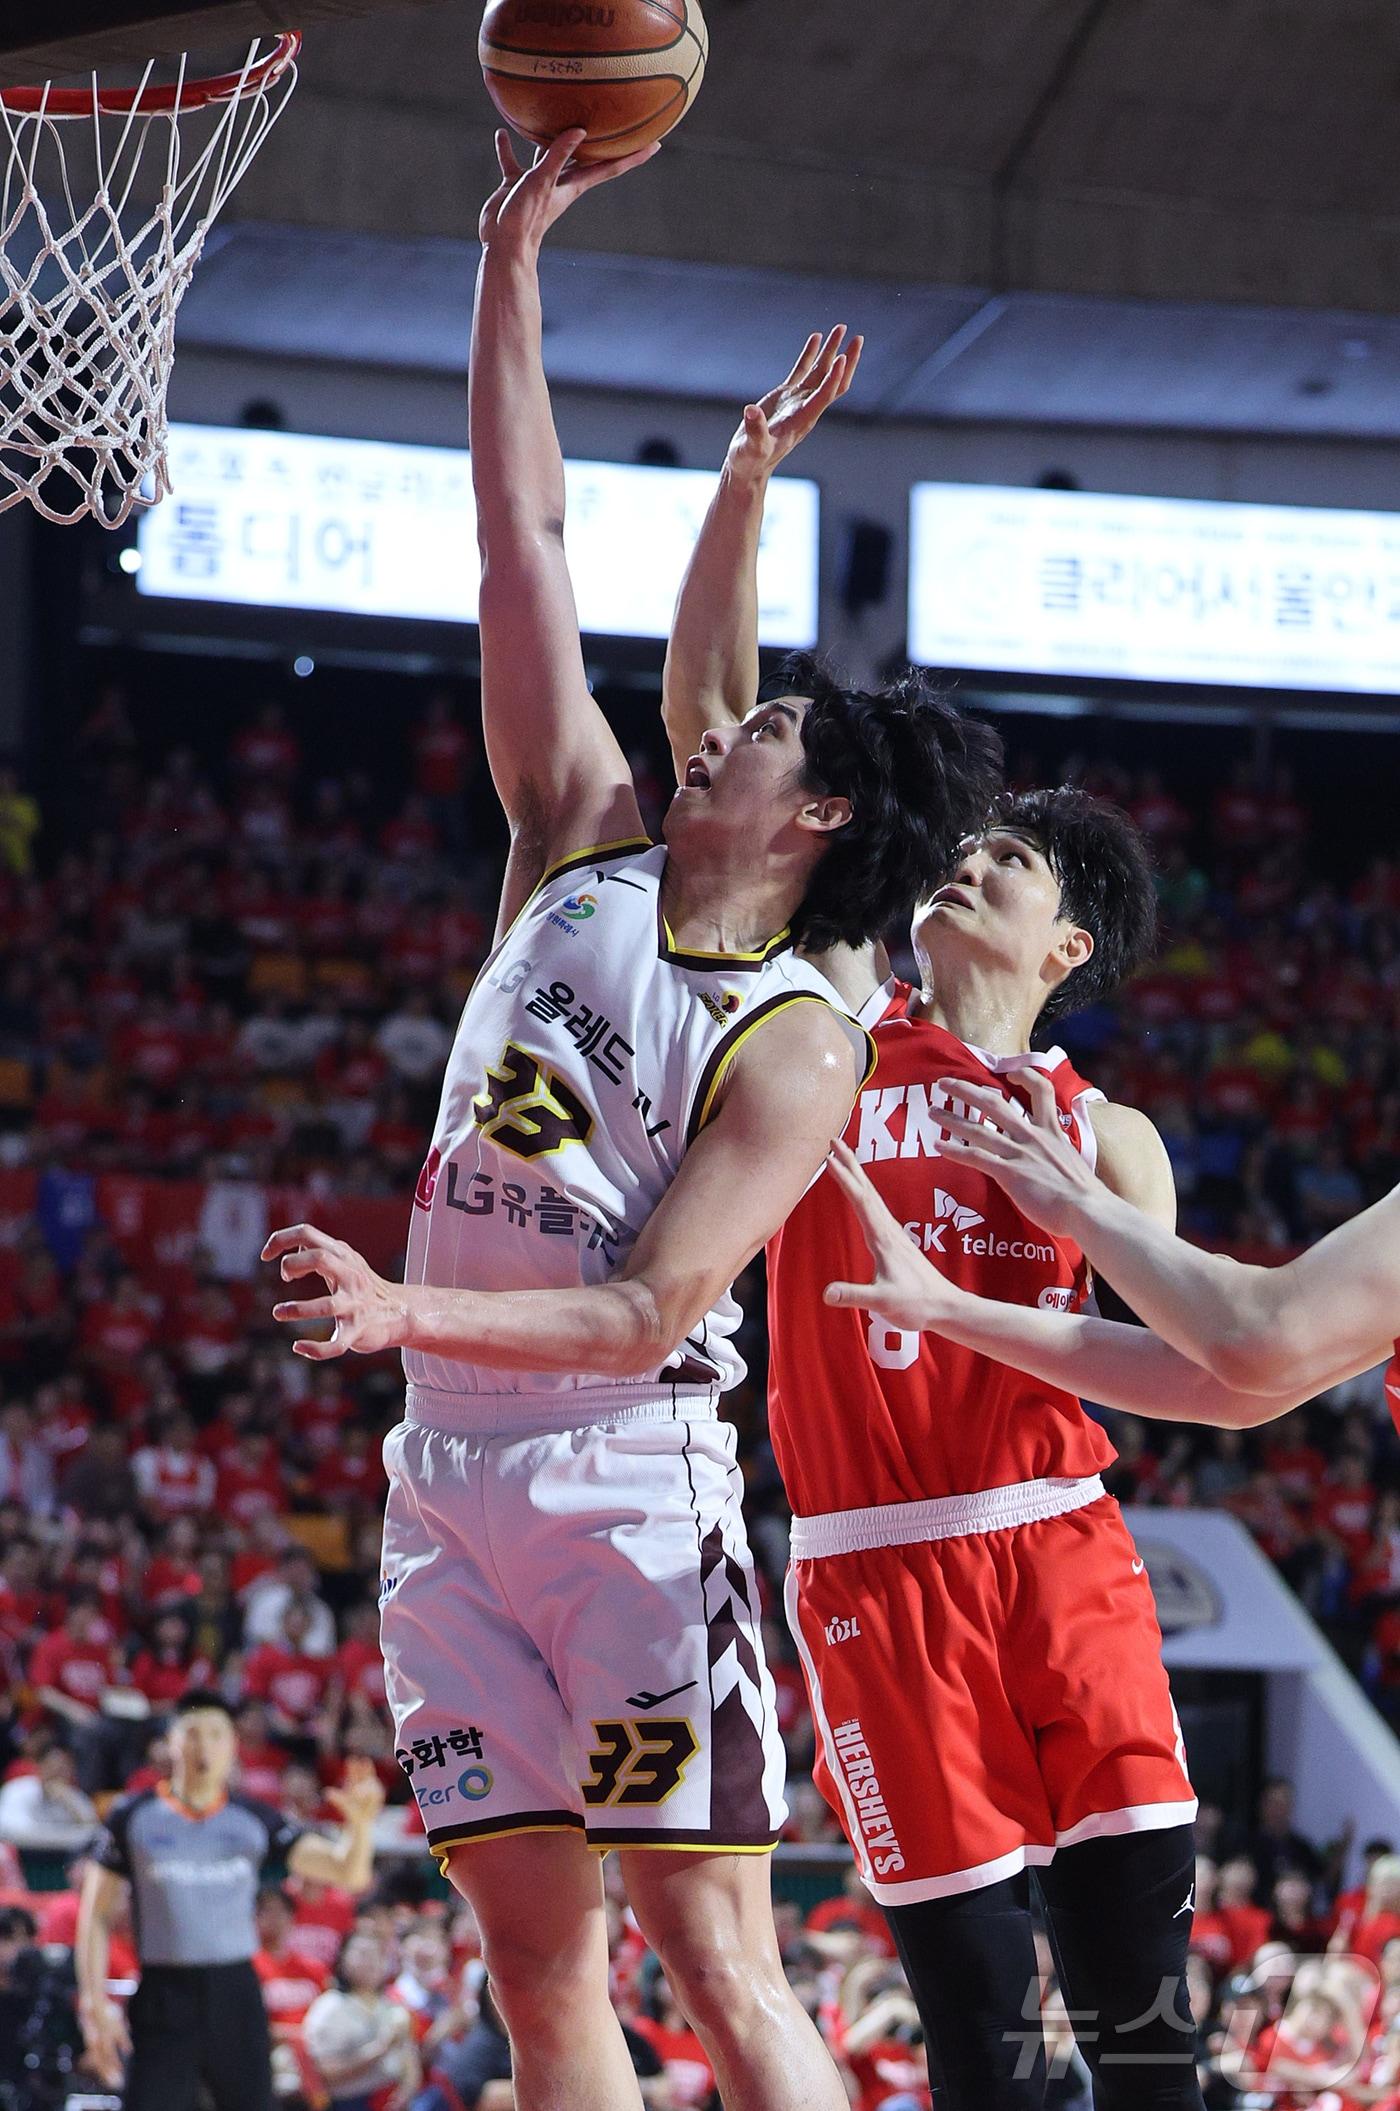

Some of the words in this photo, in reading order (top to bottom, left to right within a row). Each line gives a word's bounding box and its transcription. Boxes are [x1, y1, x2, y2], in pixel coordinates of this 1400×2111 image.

[524, 981, 636, 1086] 올레드
[472, 1039, 597, 1164] 33
[901, 1221, 949, 1253] SK
[961, 1231, 1056, 1263] telecom
[823, 1615, 861, 1647] KBL
[581, 1717, 702, 1808] 33
[832, 1720, 907, 1876] HERSHEY'S
